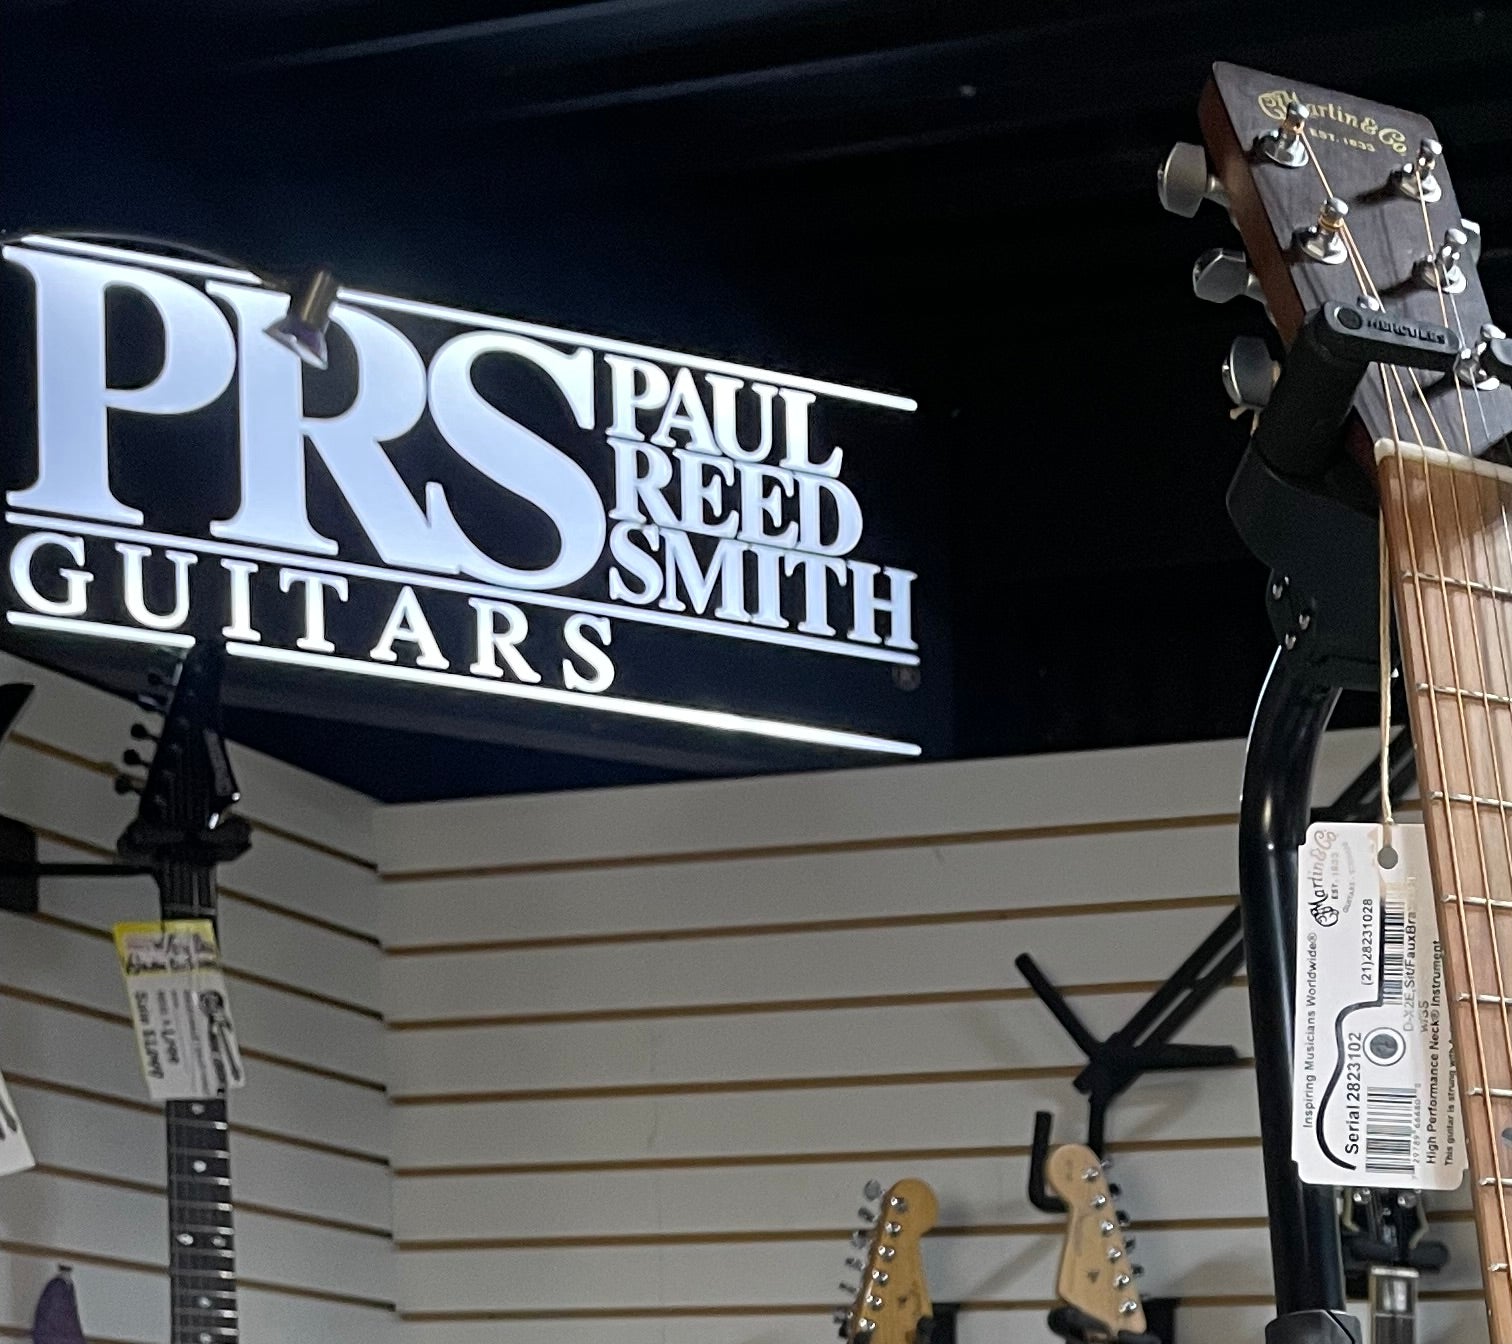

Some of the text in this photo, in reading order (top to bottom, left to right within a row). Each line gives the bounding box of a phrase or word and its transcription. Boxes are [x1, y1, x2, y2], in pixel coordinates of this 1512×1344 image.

[3, 244, 606, 592] PRS
[604, 351, 844, 480] PAUL
[607, 436, 864, 558] REED
[8, 530, 618, 693] GUITARS
[608, 522, 918, 654] SMITH
[1302, 1074, 1317, 1128] Inspiring
[1303, 1010, 1316, 1071] Musicians
[1344, 1032, 1362, 1155] Serial 2823102
[1427, 1053, 1439, 1132] Performance
[1426, 1136, 1439, 1164] High
[1444, 1147, 1454, 1166] This
